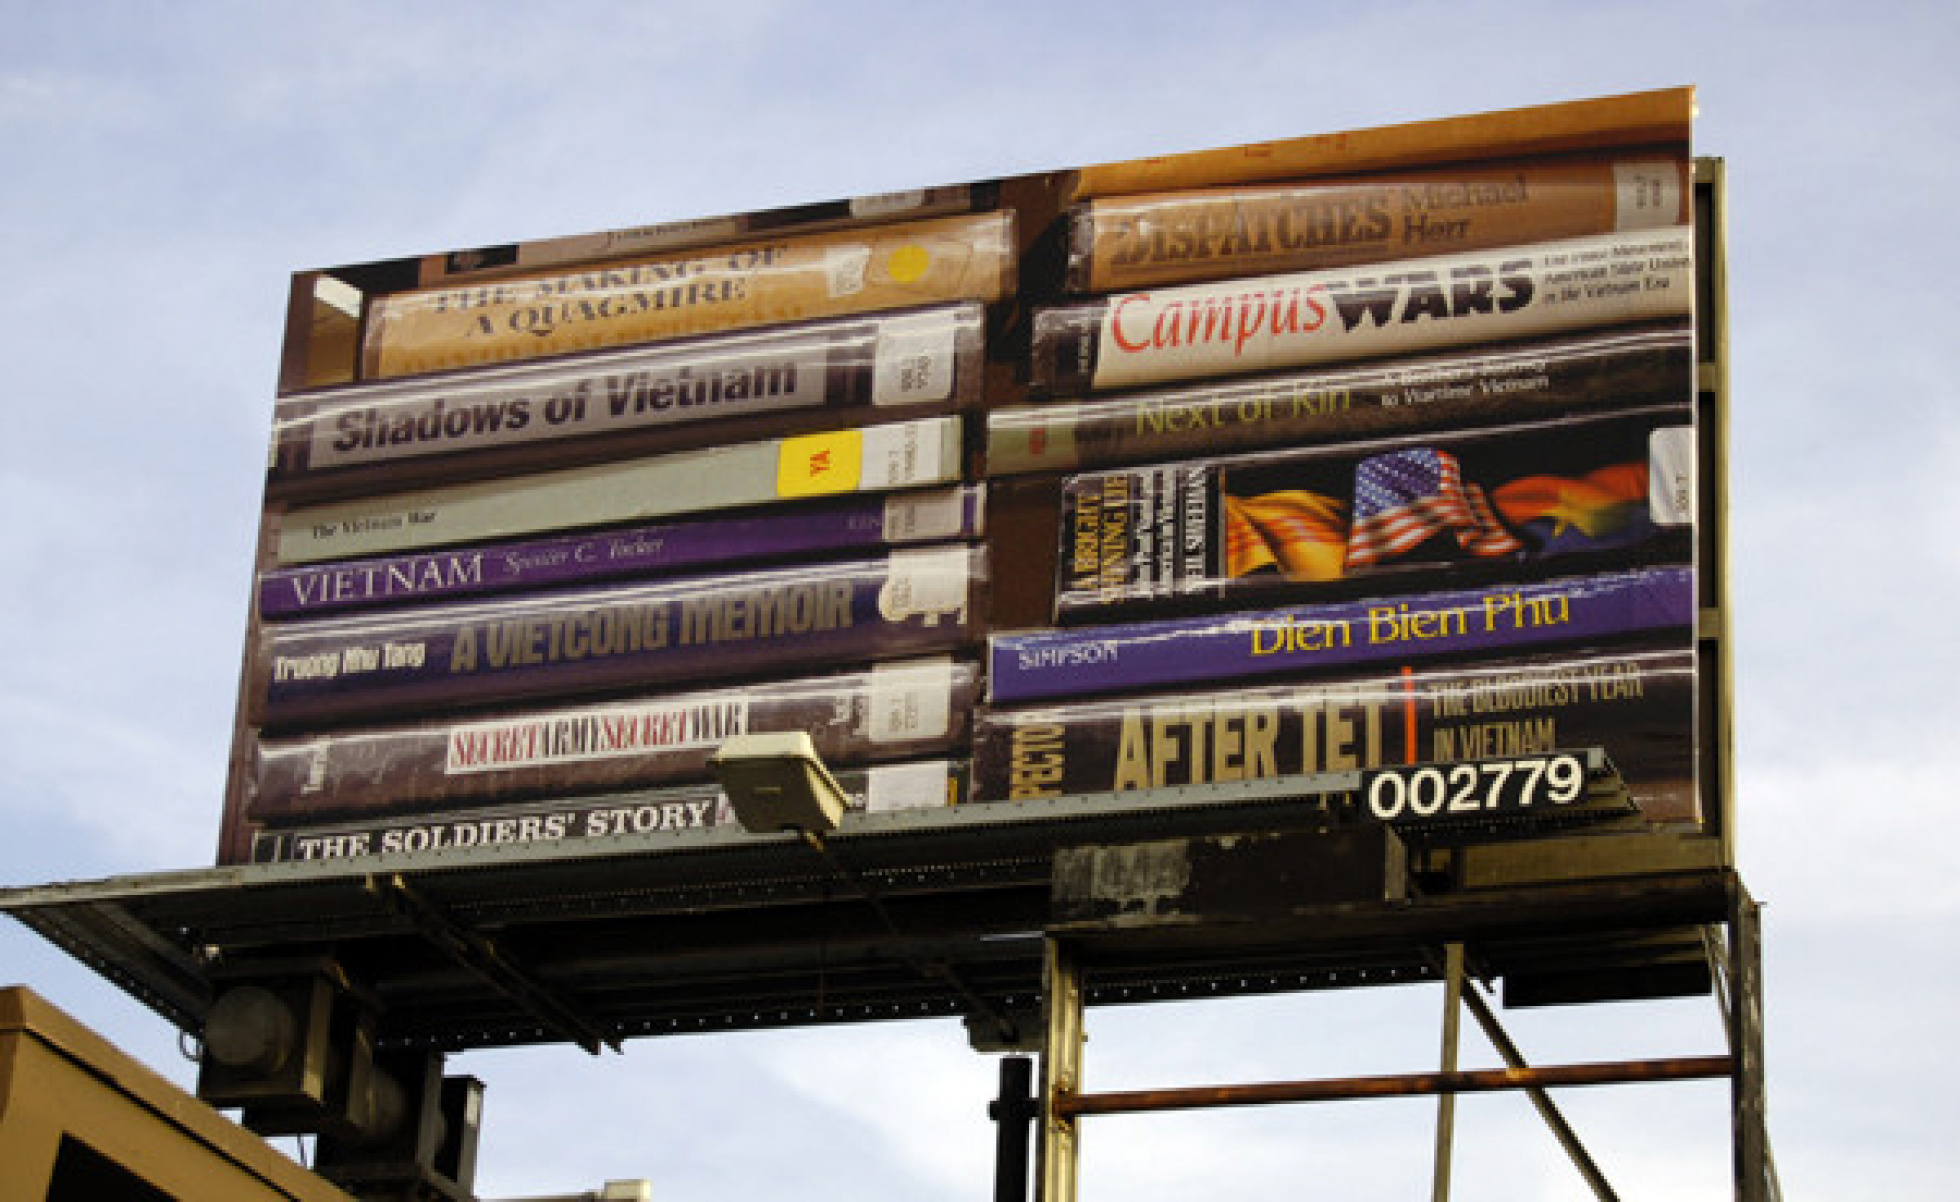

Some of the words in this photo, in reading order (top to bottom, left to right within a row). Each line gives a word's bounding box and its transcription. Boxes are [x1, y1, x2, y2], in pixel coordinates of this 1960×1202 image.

[1401, 172, 1529, 210] Michael
[1108, 198, 1391, 263] DISPATCHES
[1404, 213, 1470, 243] Herr
[429, 286, 514, 313] THE
[536, 259, 706, 295] MAKING
[728, 244, 788, 269] OF
[465, 313, 493, 337] A
[508, 277, 746, 337] QUAGMIRE
[1111, 283, 1327, 356] Campus
[1328, 260, 1534, 333] WARS
[331, 398, 530, 452] Shadows
[544, 378, 593, 427] of
[606, 362, 798, 417] Vietnam
[1136, 398, 1226, 437] Next
[1238, 389, 1276, 422] of
[1292, 380, 1352, 419] Kin
[809, 447, 831, 478] YA
[293, 552, 484, 604] VIETNAM
[384, 641, 427, 668] Tang
[449, 624, 478, 675] A
[486, 604, 670, 672] VIETCONG
[677, 579, 854, 647] MEMOIR
[1018, 641, 1118, 671] SIMPSON
[1250, 613, 1352, 656] Dien
[1367, 603, 1468, 645] Bien
[1482, 590, 1571, 632] Phu
[1429, 682, 1468, 719] THE
[1583, 661, 1644, 701] YEAR
[1114, 701, 1281, 791] AFTER
[1294, 684, 1392, 776] TET
[1432, 727, 1455, 763] IN
[1459, 716, 1556, 761] VIETNAM
[1367, 755, 1583, 820] 002779
[299, 833, 370, 862] THE
[381, 812, 576, 854] SOLDIERS'
[586, 800, 711, 836] STORY
